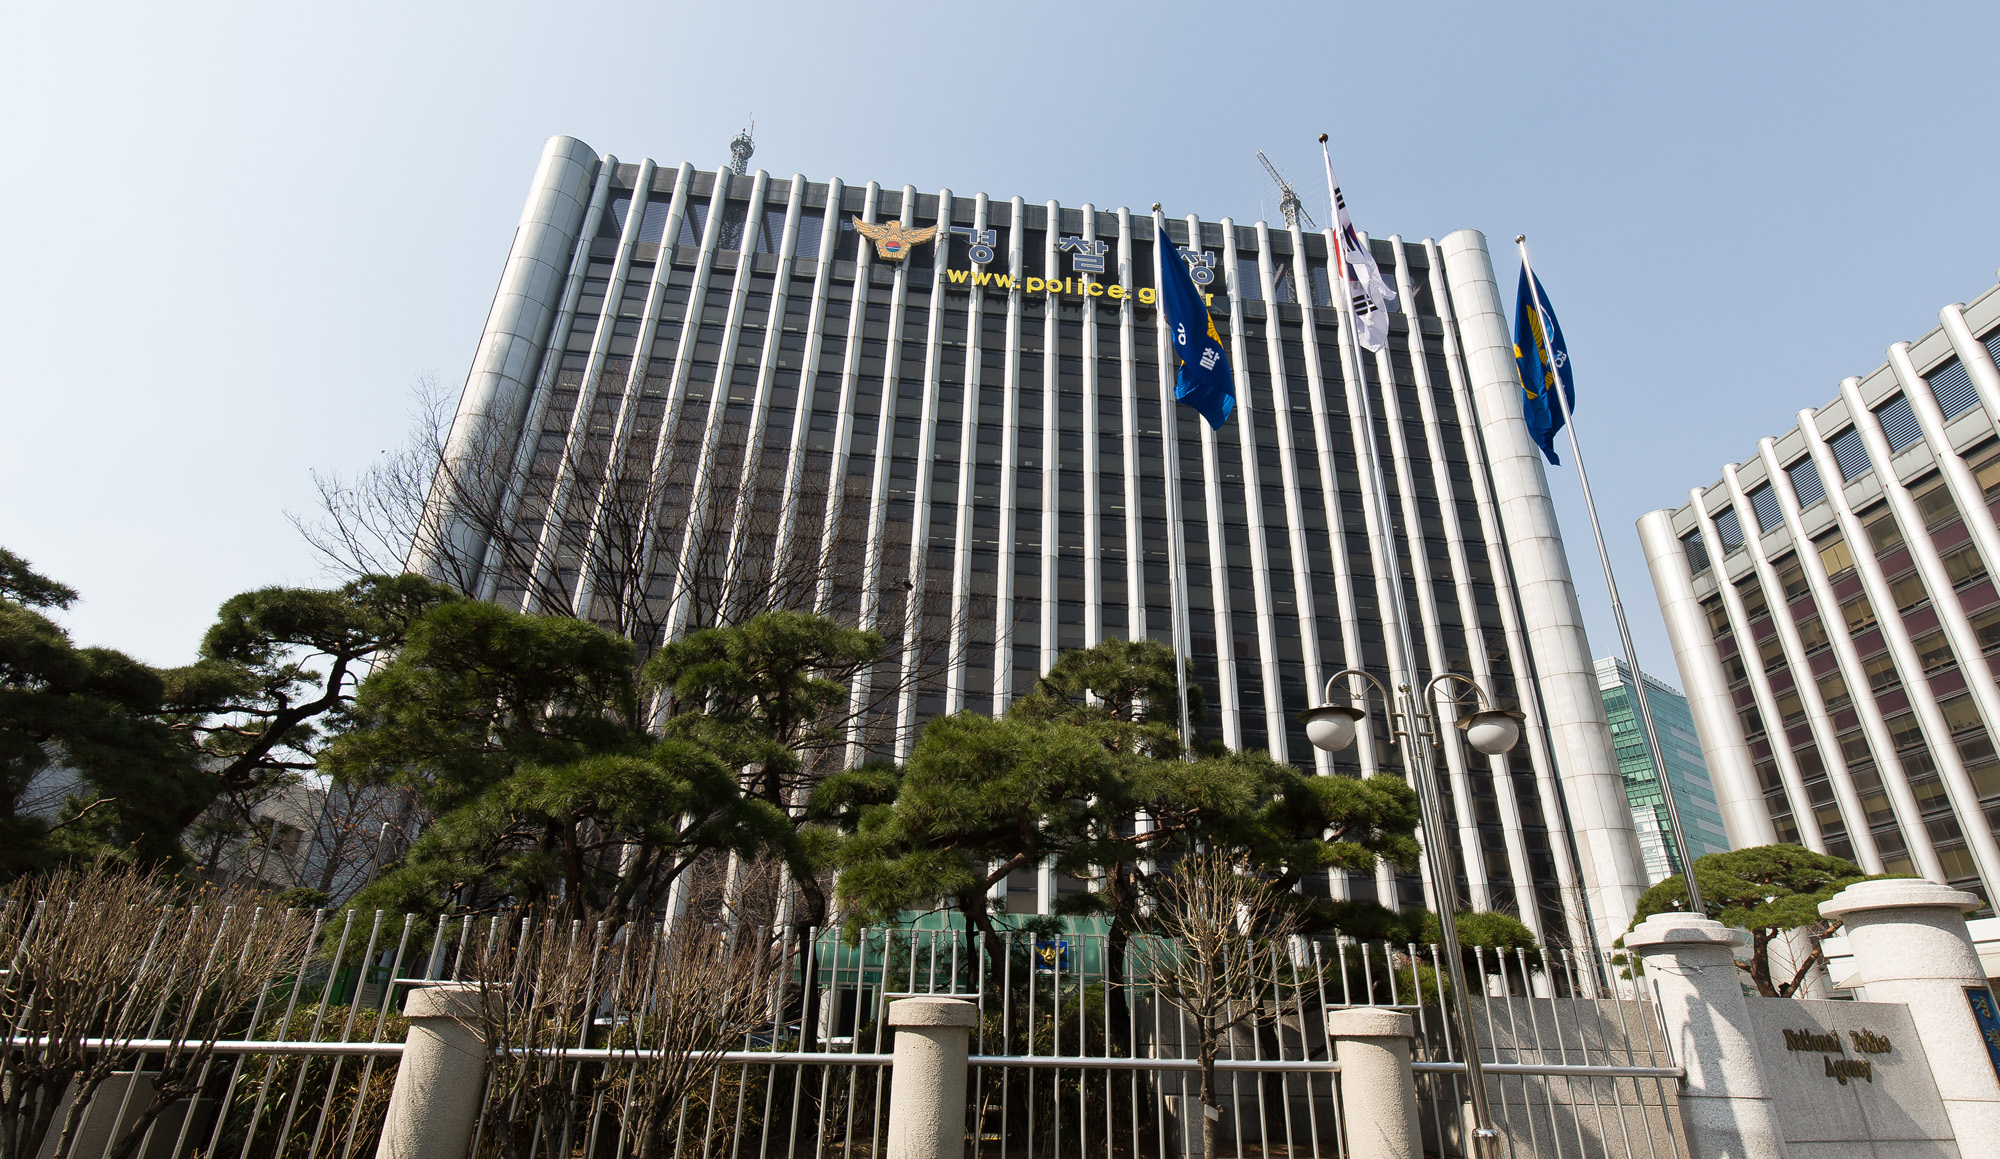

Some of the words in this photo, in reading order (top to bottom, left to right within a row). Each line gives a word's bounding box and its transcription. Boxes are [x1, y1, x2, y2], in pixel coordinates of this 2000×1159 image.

[947, 267, 1214, 307] www.police.gr
[1782, 1028, 1843, 1053] National
[1849, 1027, 1892, 1053] Police
[1823, 1055, 1872, 1086] Agency
